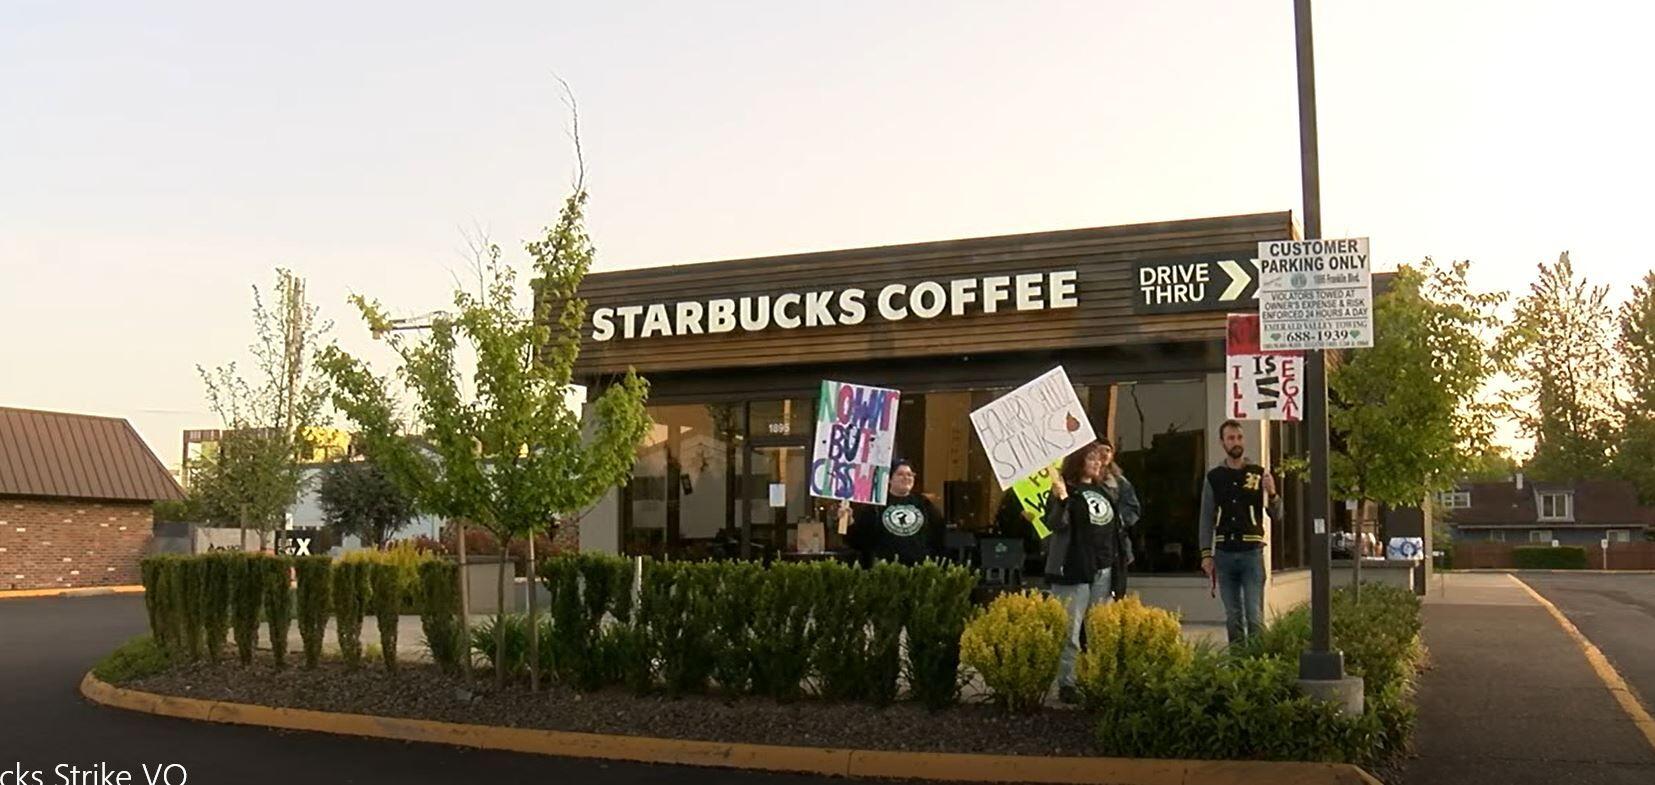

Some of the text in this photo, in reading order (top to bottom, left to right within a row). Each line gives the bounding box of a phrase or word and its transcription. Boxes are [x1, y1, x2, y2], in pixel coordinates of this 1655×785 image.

[1270, 240, 1357, 256] CUSTOMER
[1261, 255, 1366, 273] PARKING ONLY
[1140, 263, 1209, 285] DRIVE
[1140, 283, 1205, 305] THRU
[1271, 289, 1355, 301] VIOLATORS TOWED AT
[592, 270, 1078, 341] STARBUCKS COFFEE
[1301, 299, 1337, 309] EXPENSE
[1346, 298, 1366, 307] RISK
[1262, 307, 1368, 319] ENFORCED 24 HOURS A DAY
[1264, 322, 1302, 331] EMERALD
[1335, 320, 1368, 329] TOWING
[1286, 329, 1348, 342] 688-1939
[1252, 354, 1277, 375] IS
[829, 424, 876, 463] BUT
[991, 412, 1076, 480] STINKS
